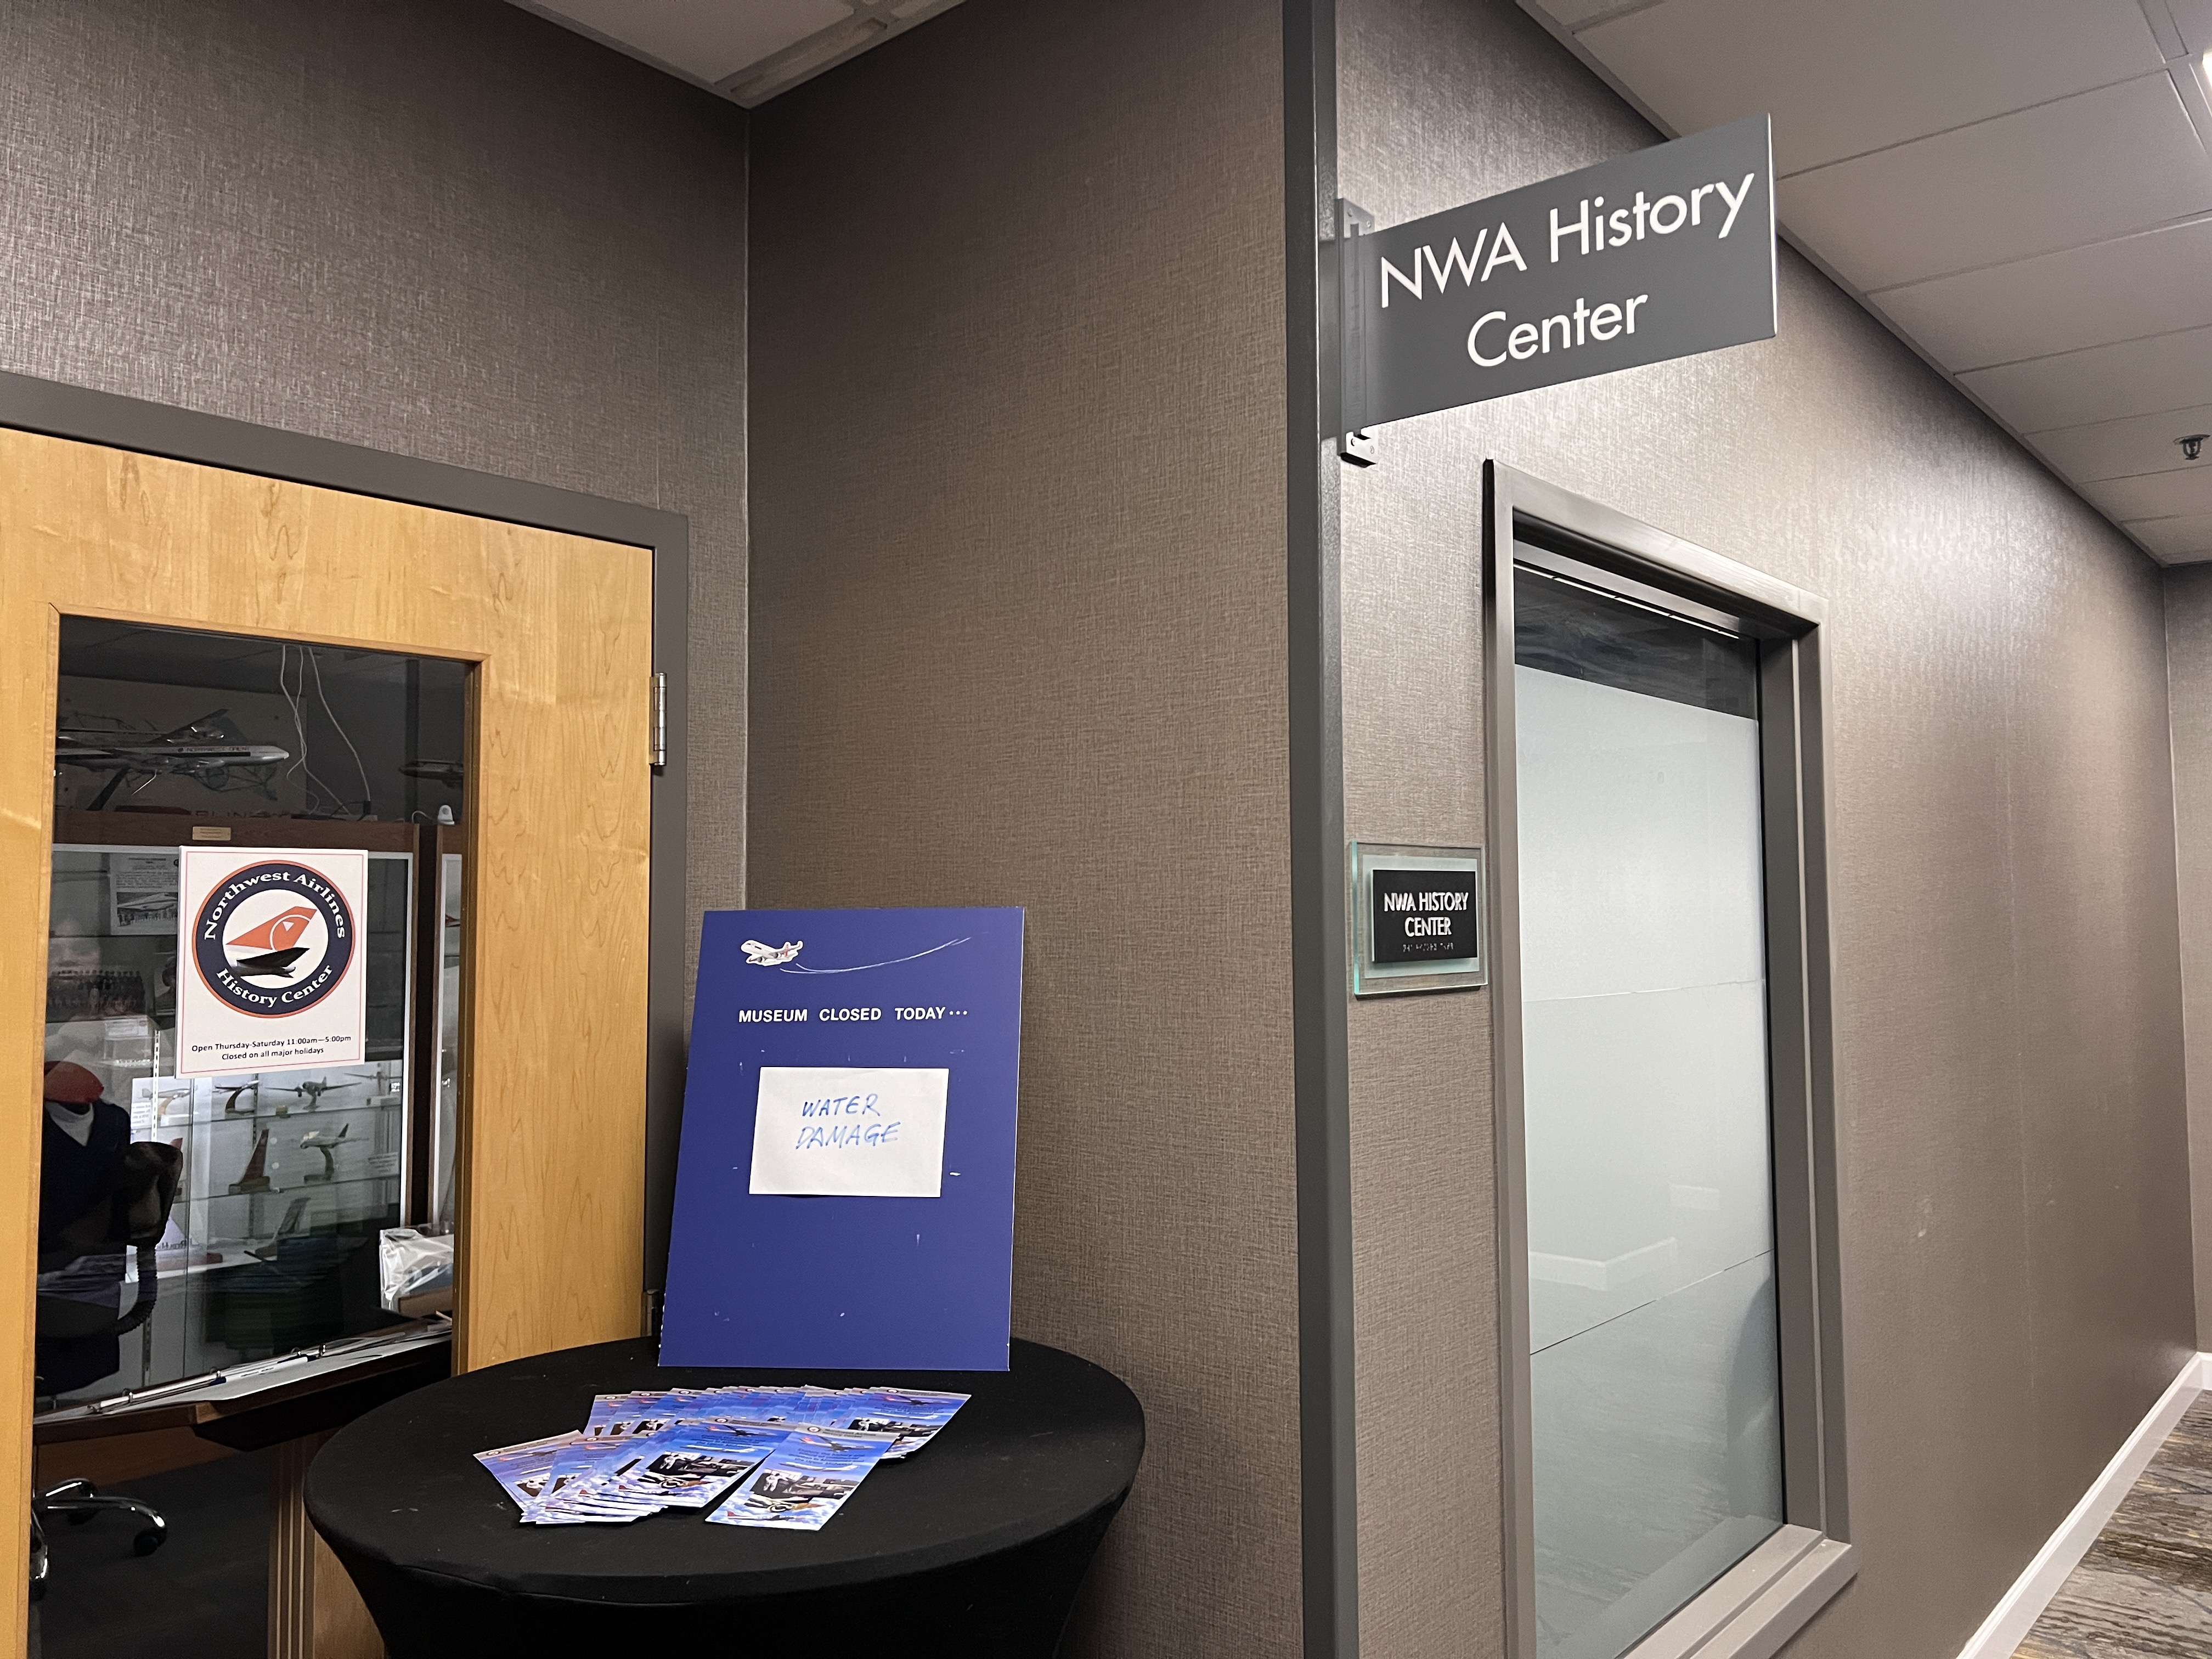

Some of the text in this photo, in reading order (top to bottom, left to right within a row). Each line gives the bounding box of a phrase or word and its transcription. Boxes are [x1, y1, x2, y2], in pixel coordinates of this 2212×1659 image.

[1380, 173, 1754, 308] NWA History
[1467, 294, 1648, 367] Center
[204, 871, 346, 940] Northwest Airlines
[1384, 891, 1469, 912] NWA HISTORY
[1404, 917, 1452, 937] CENTER
[216, 964, 334, 1008] History Center
[738, 1008, 808, 1023] MUSEUM
[819, 1008, 882, 1022] CLOSED
[191, 1044, 213, 1053] Open
[215, 1039, 285, 1052] Thursday-Saturday
[222, 1051, 247, 1060] Closed
[271, 1048, 293, 1058] major
[295, 1046, 324, 1056] holidays
[802, 1092, 881, 1118] WATER
[795, 1120, 901, 1150] DAMAGE
